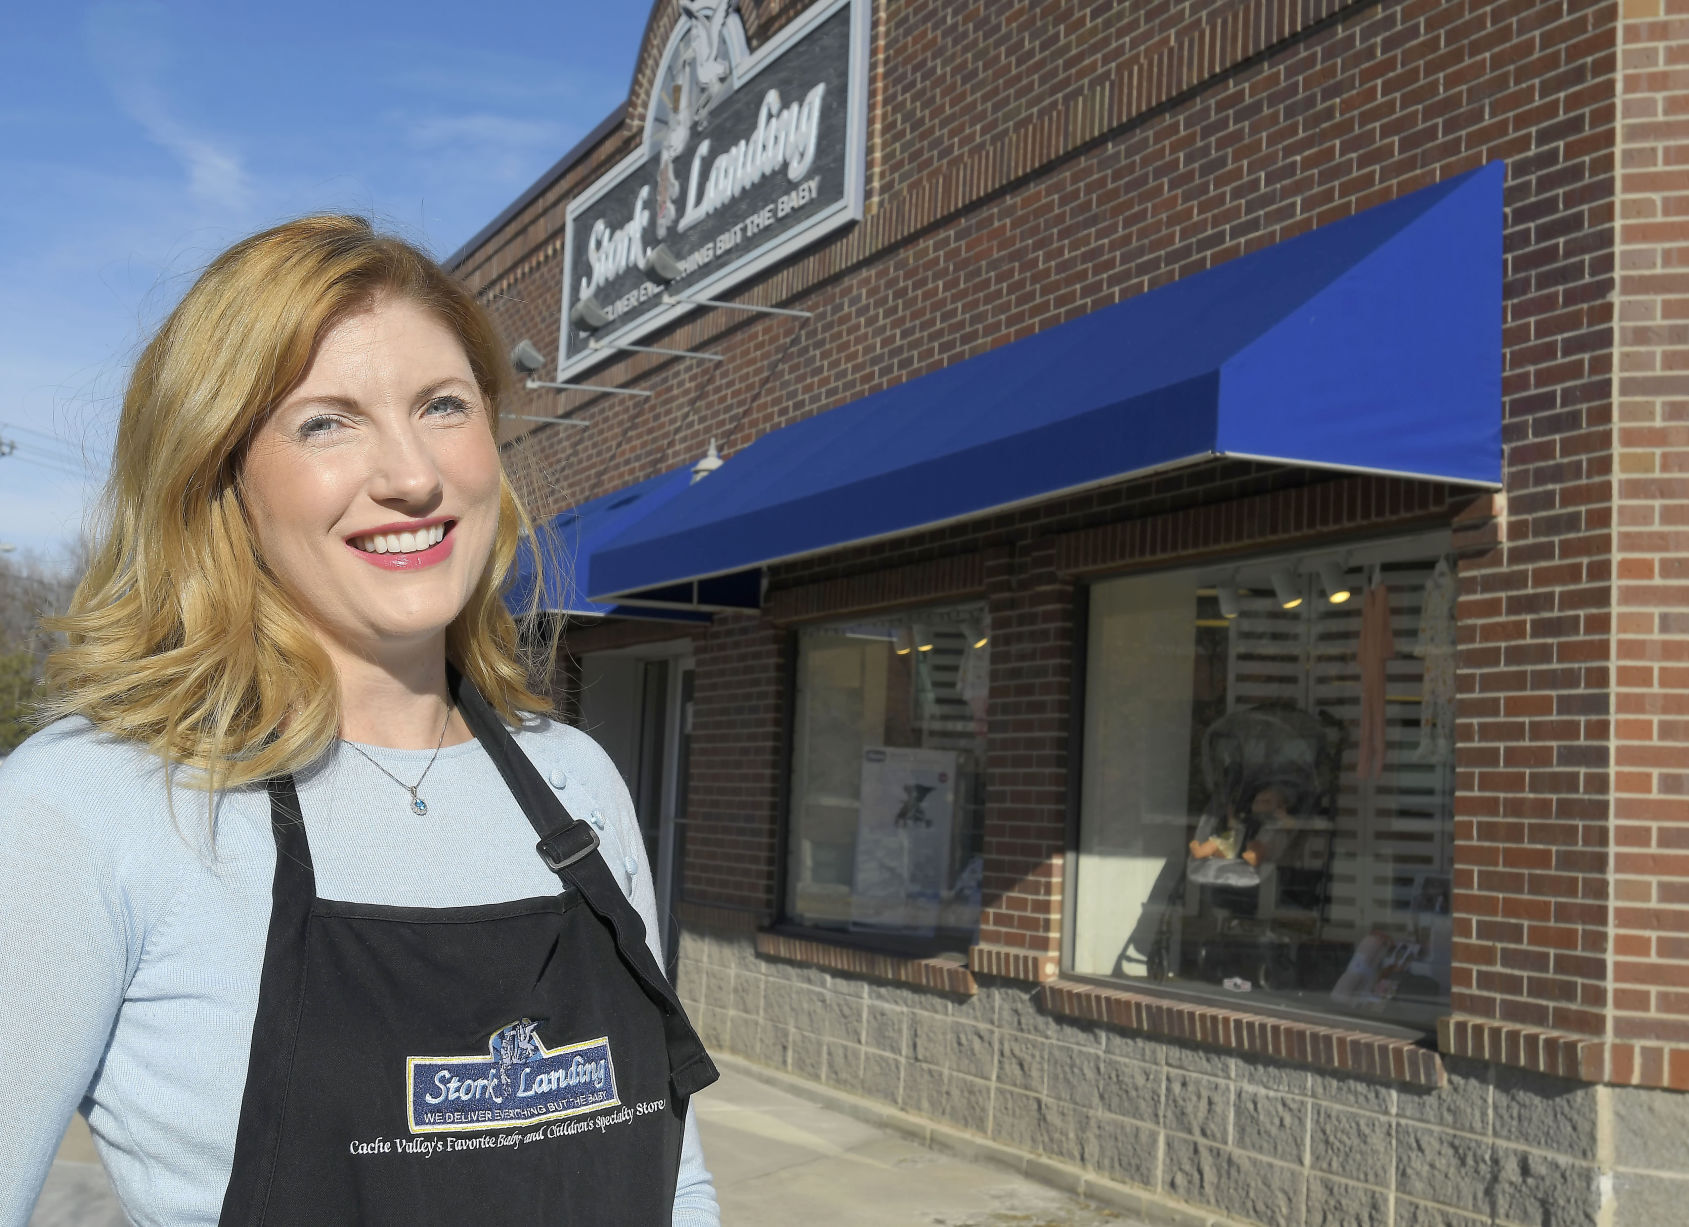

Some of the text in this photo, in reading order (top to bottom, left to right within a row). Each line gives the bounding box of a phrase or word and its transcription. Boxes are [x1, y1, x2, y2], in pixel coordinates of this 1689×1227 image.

[677, 82, 826, 233] Landing
[599, 288, 640, 321] ELIVER
[715, 222, 744, 257] BUT
[744, 203, 776, 237] THE
[776, 175, 821, 219] BABY
[425, 1055, 607, 1104] Stork Landing
[349, 1099, 666, 1158] Cache Valley's Favorite Baby and Children's Specialty Store
[424, 1112, 444, 1123] WE
[445, 1110, 493, 1123] DELIVER
[547, 1098, 569, 1114] BUT
